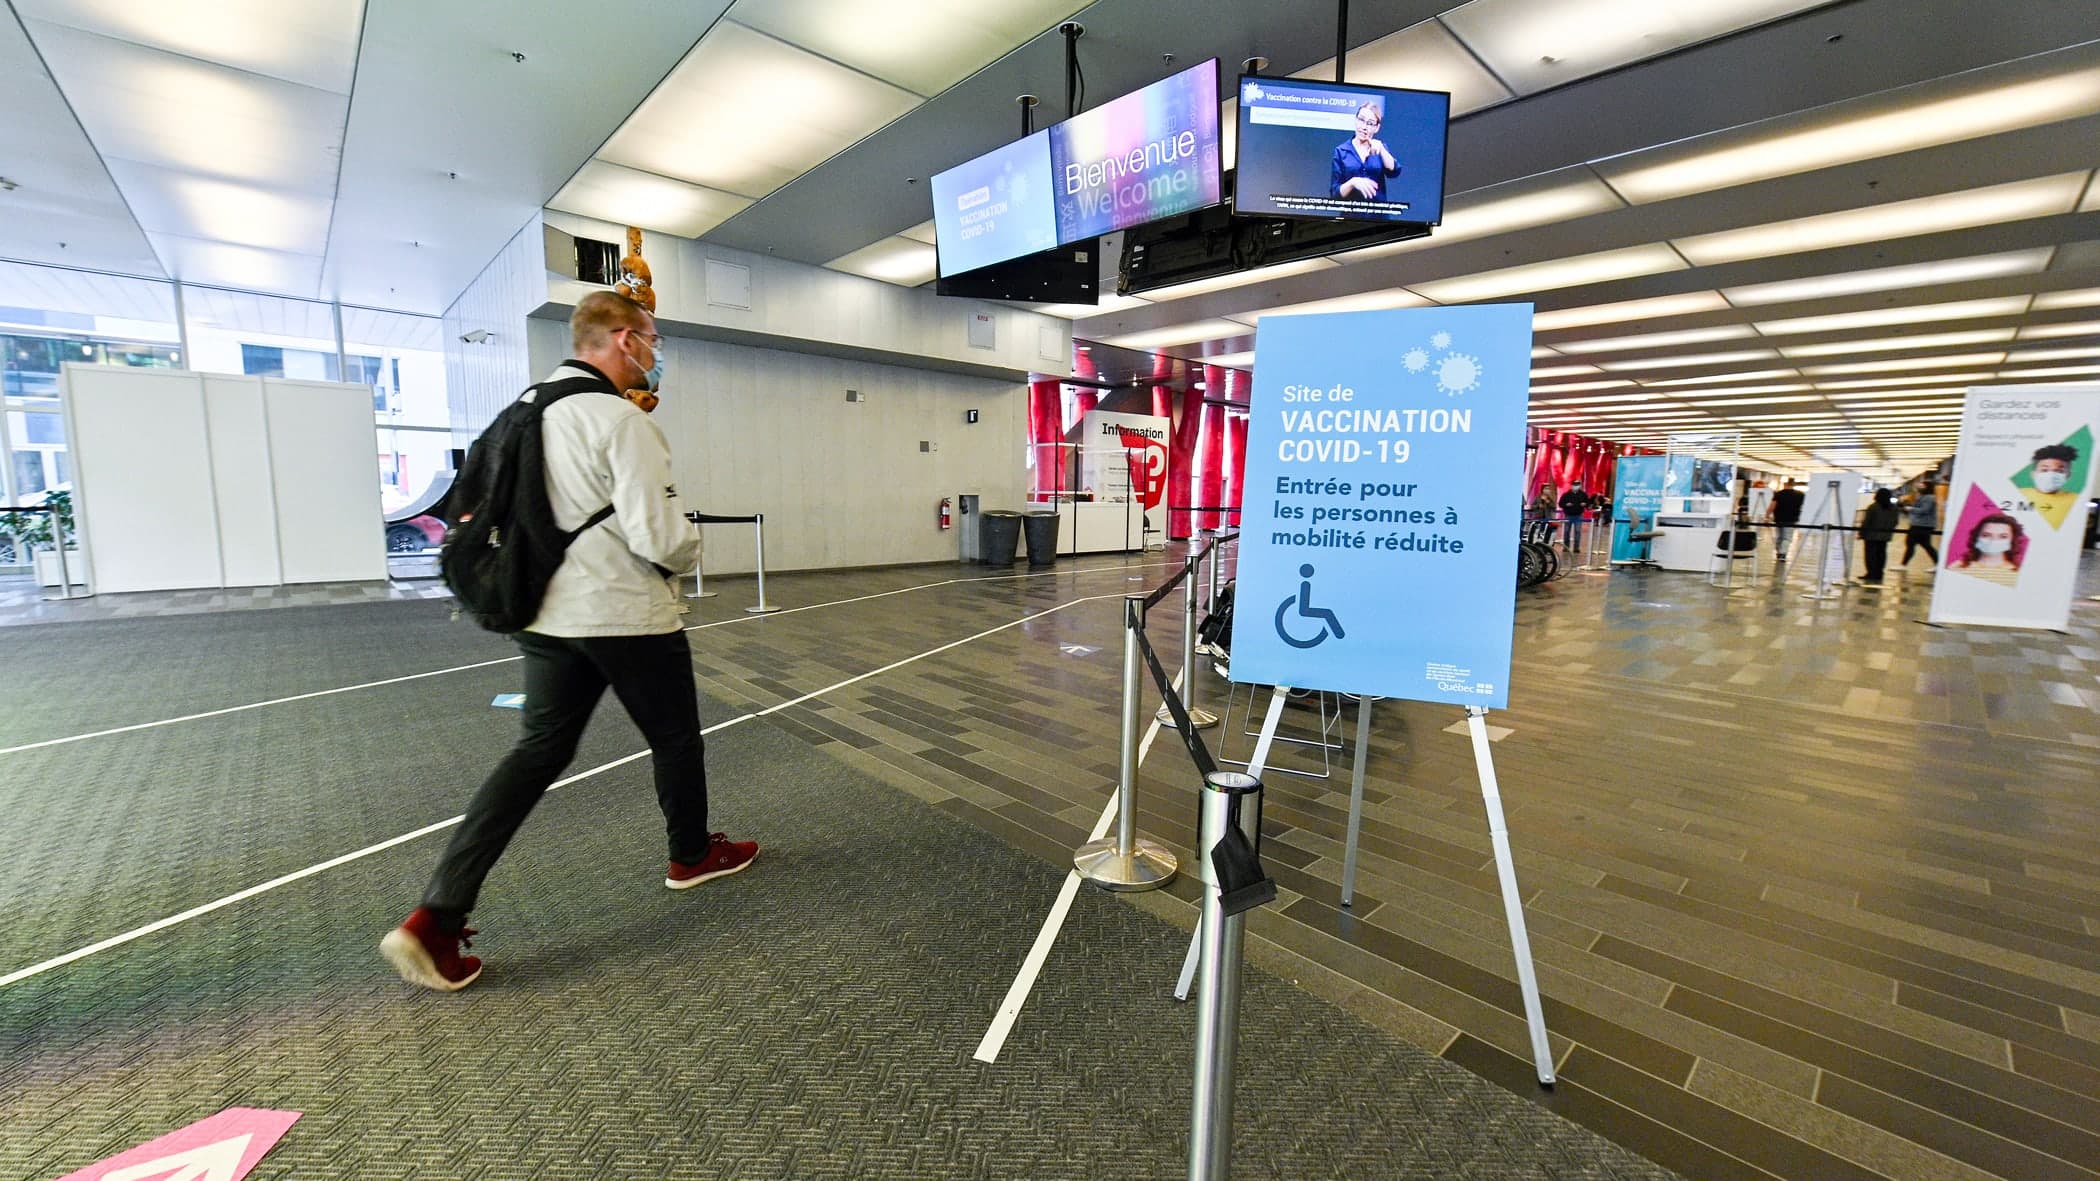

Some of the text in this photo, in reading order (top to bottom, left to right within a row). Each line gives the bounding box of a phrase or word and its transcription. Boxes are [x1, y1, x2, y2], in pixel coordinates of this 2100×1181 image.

[1266, 92, 1301, 103] Vaccination
[1302, 97, 1322, 105] contre
[1329, 98, 1357, 107] COVID-19
[1066, 130, 1195, 195] Bienvenue
[1077, 169, 1187, 219] Welcome
[1283, 384, 1354, 402] Site de
[1979, 399, 2062, 409] Gardez vos
[1281, 409, 1471, 433] VACCINATION
[1976, 411, 2047, 420] distances
[1102, 423, 1164, 439] Information
[1278, 439, 1410, 463] COVID-19
[1276, 476, 1418, 501] Entrée pour
[1273, 500, 1458, 525] les personnes à
[1999, 500, 2036, 512] 2 M
[1271, 528, 1464, 554] mobilité réduite
[1438, 681, 1475, 693] Québec
